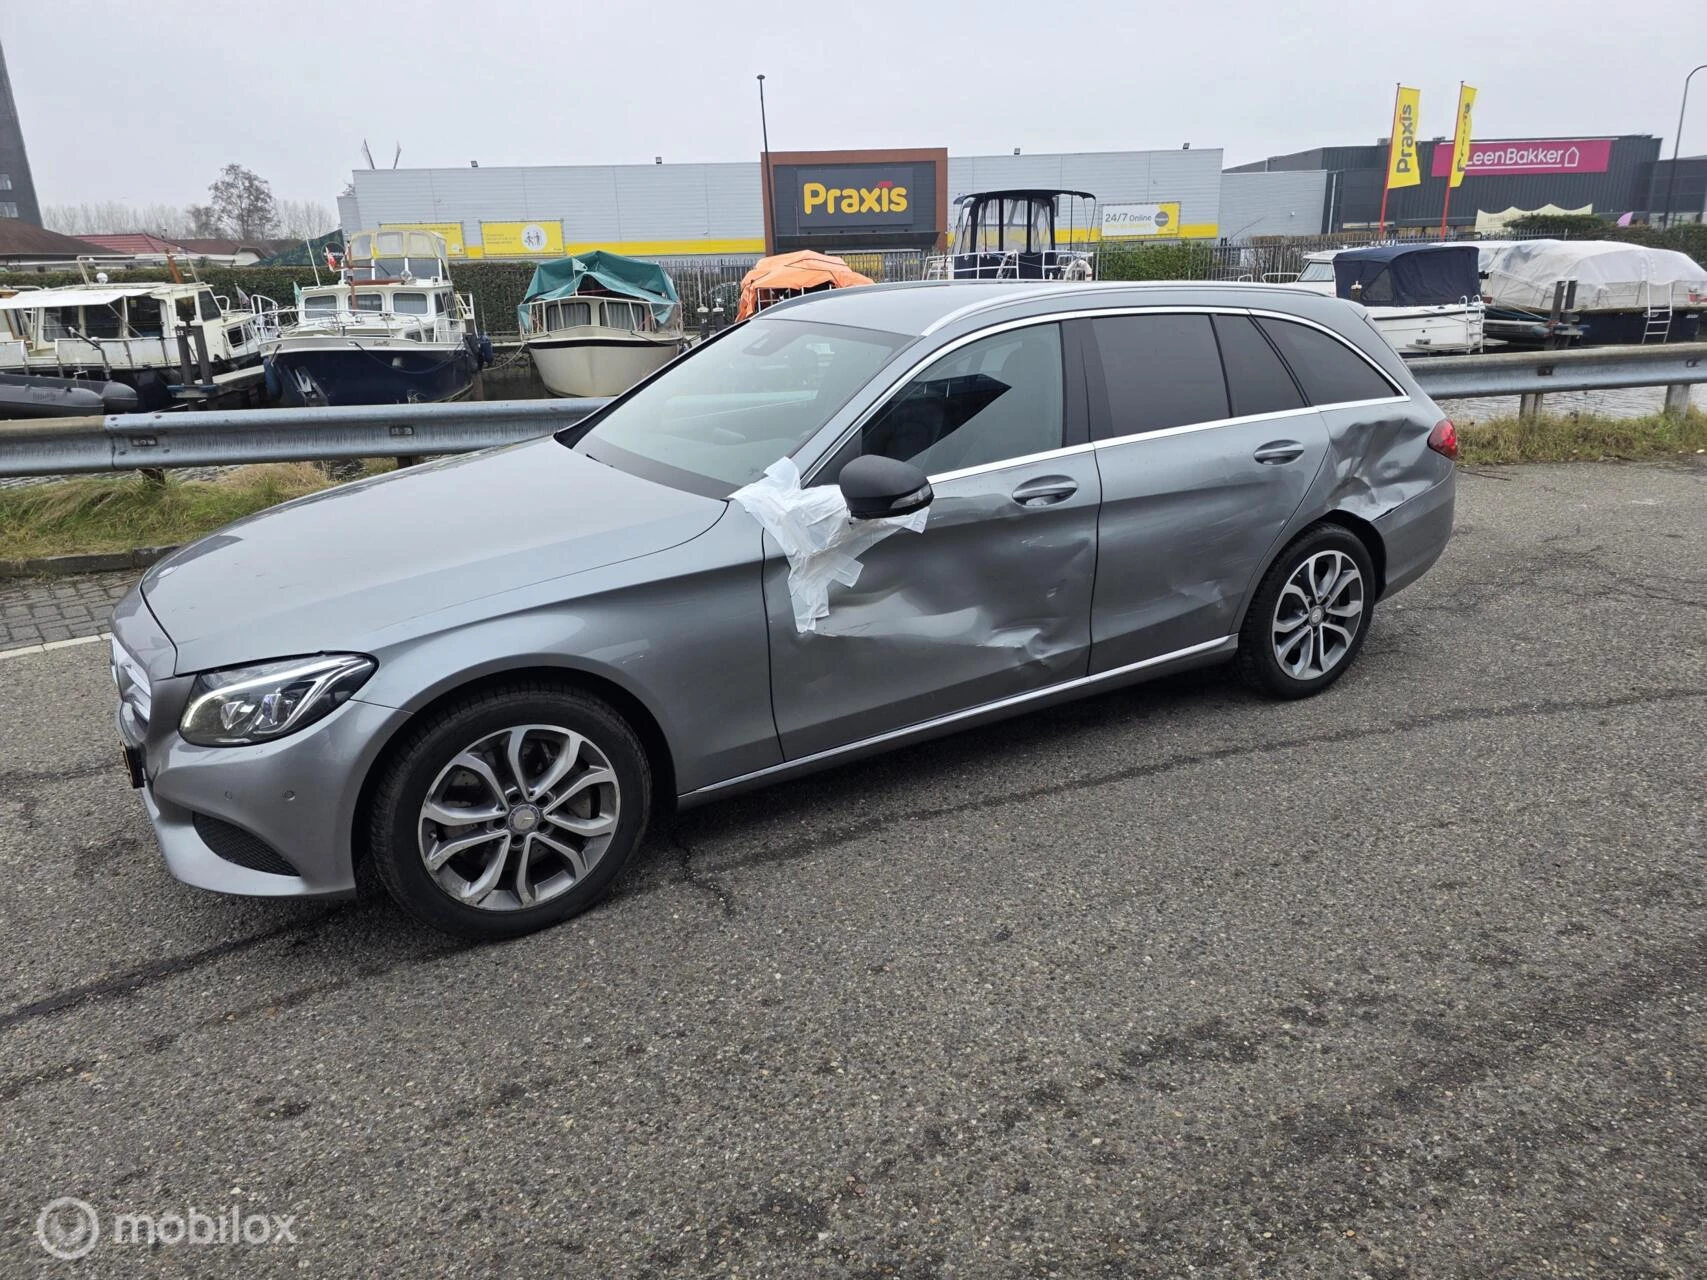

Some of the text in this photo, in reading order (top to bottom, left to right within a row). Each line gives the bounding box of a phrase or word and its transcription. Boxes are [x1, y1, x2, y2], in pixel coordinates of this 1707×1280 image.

[1396, 103, 1414, 174] Praxis
[803, 182, 908, 215] Praxis
[1105, 213, 1128, 222] 24/7
